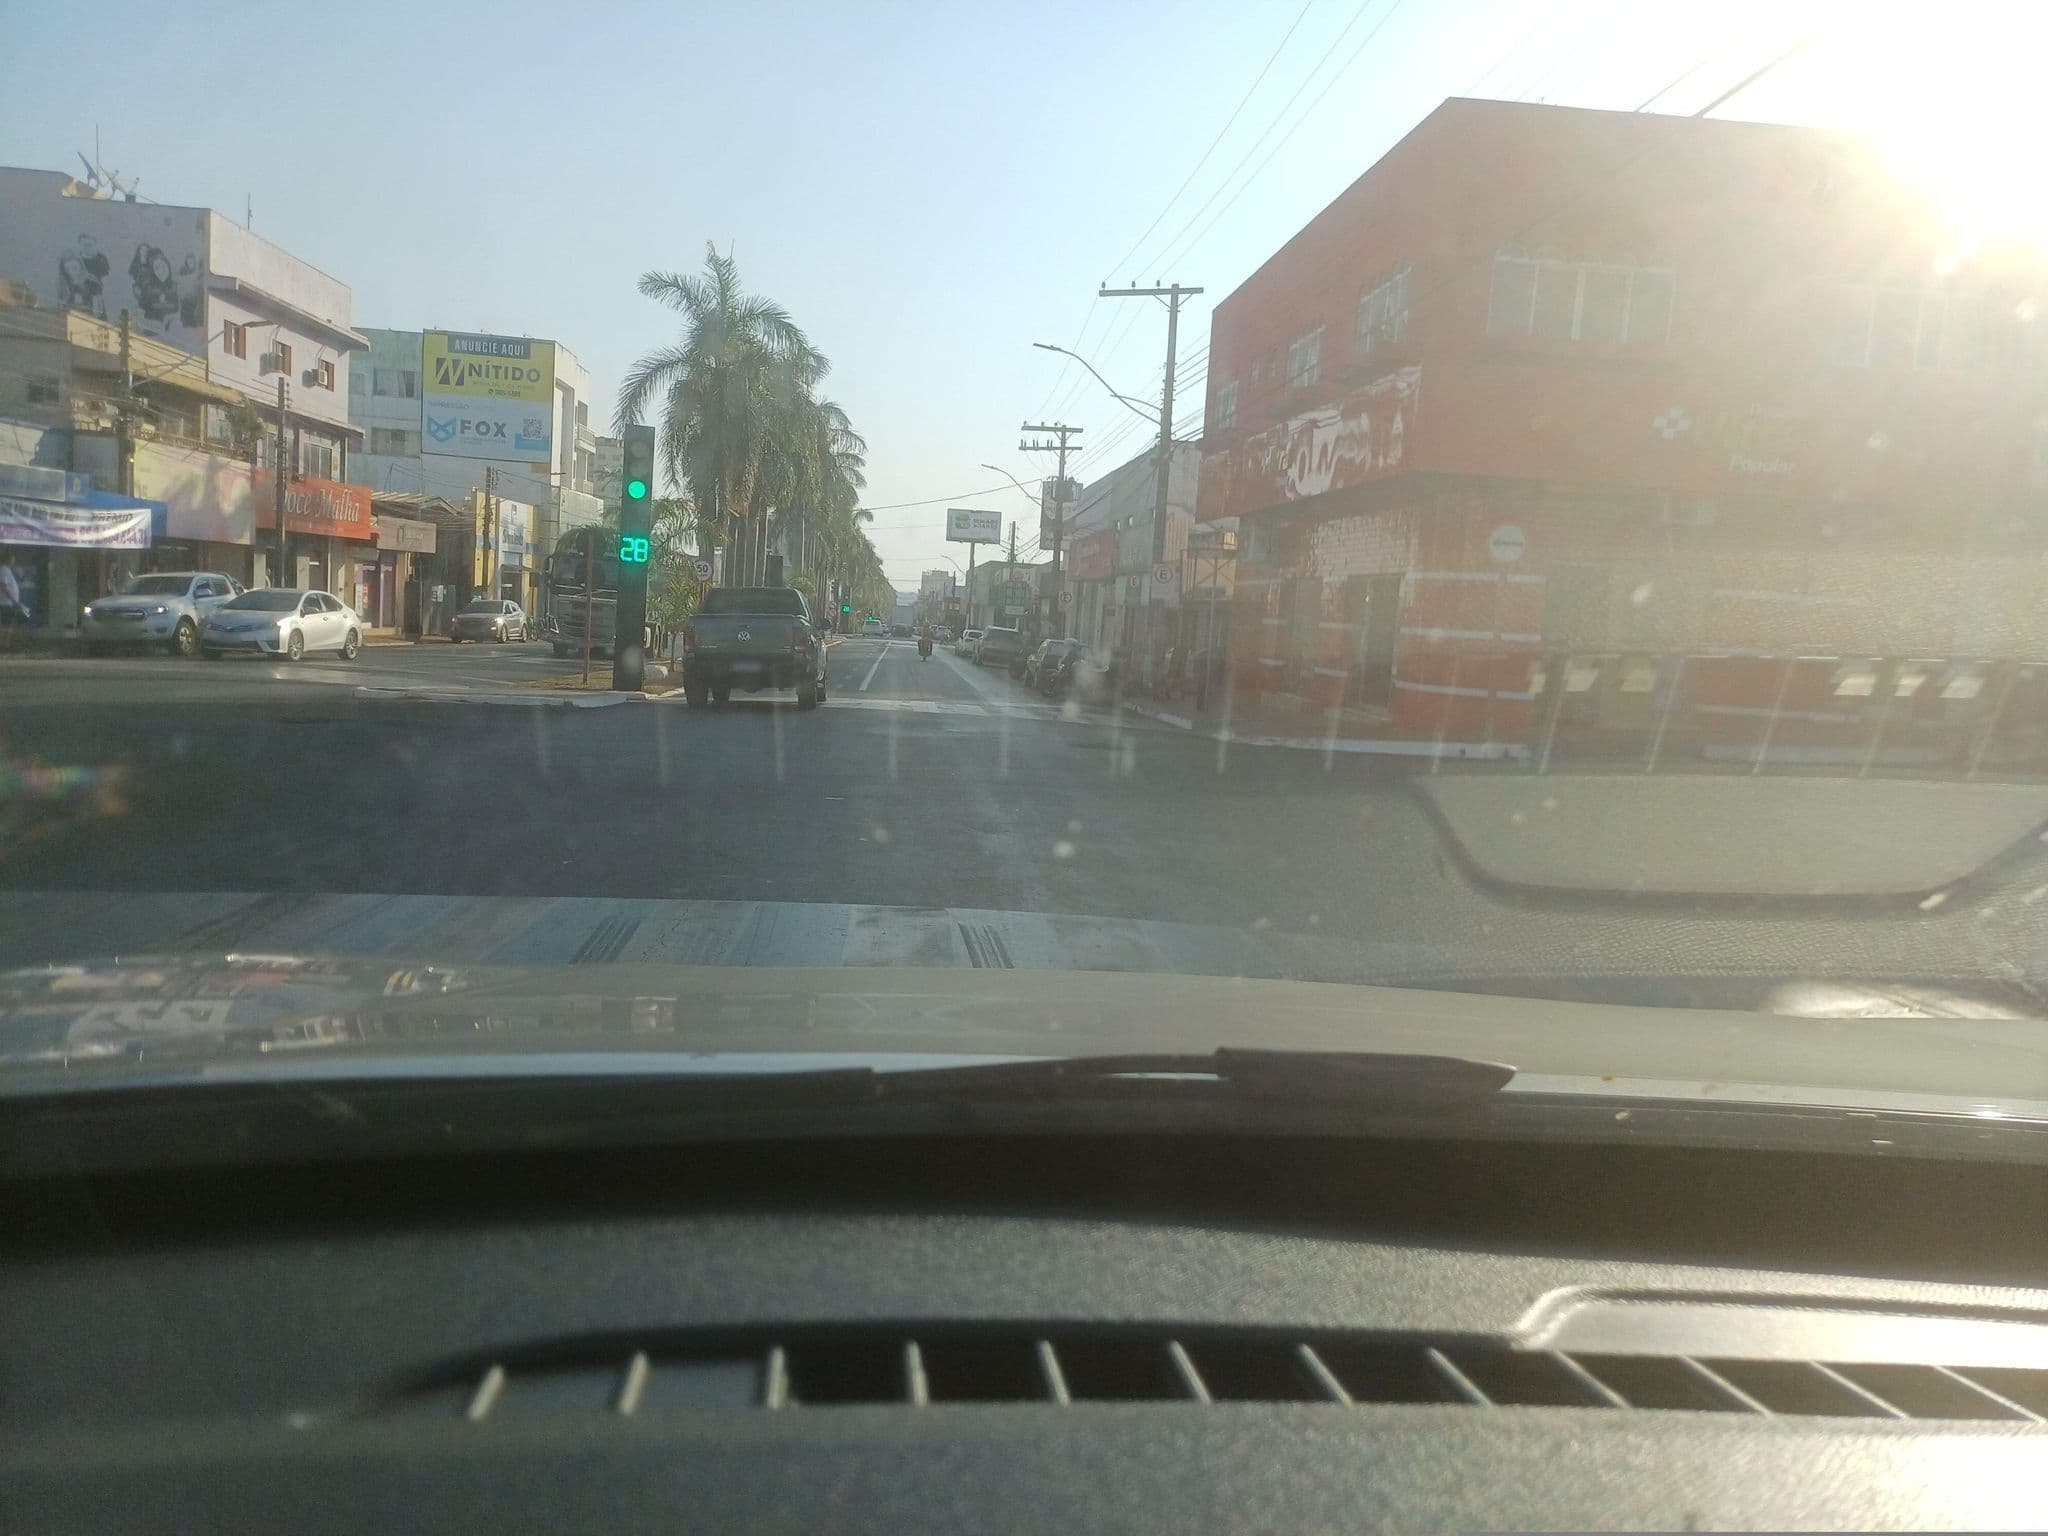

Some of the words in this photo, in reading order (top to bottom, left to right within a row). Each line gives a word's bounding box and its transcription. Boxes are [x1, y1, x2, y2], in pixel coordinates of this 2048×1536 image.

[454, 340, 498, 354] ANUNCIE
[501, 343, 524, 356] AQUI
[468, 360, 542, 383] NÍTIDO
[460, 420, 507, 438] FOX
[315, 489, 360, 523] Malha
[620, 537, 649, 562] 28
[697, 564, 708, 573] 50
